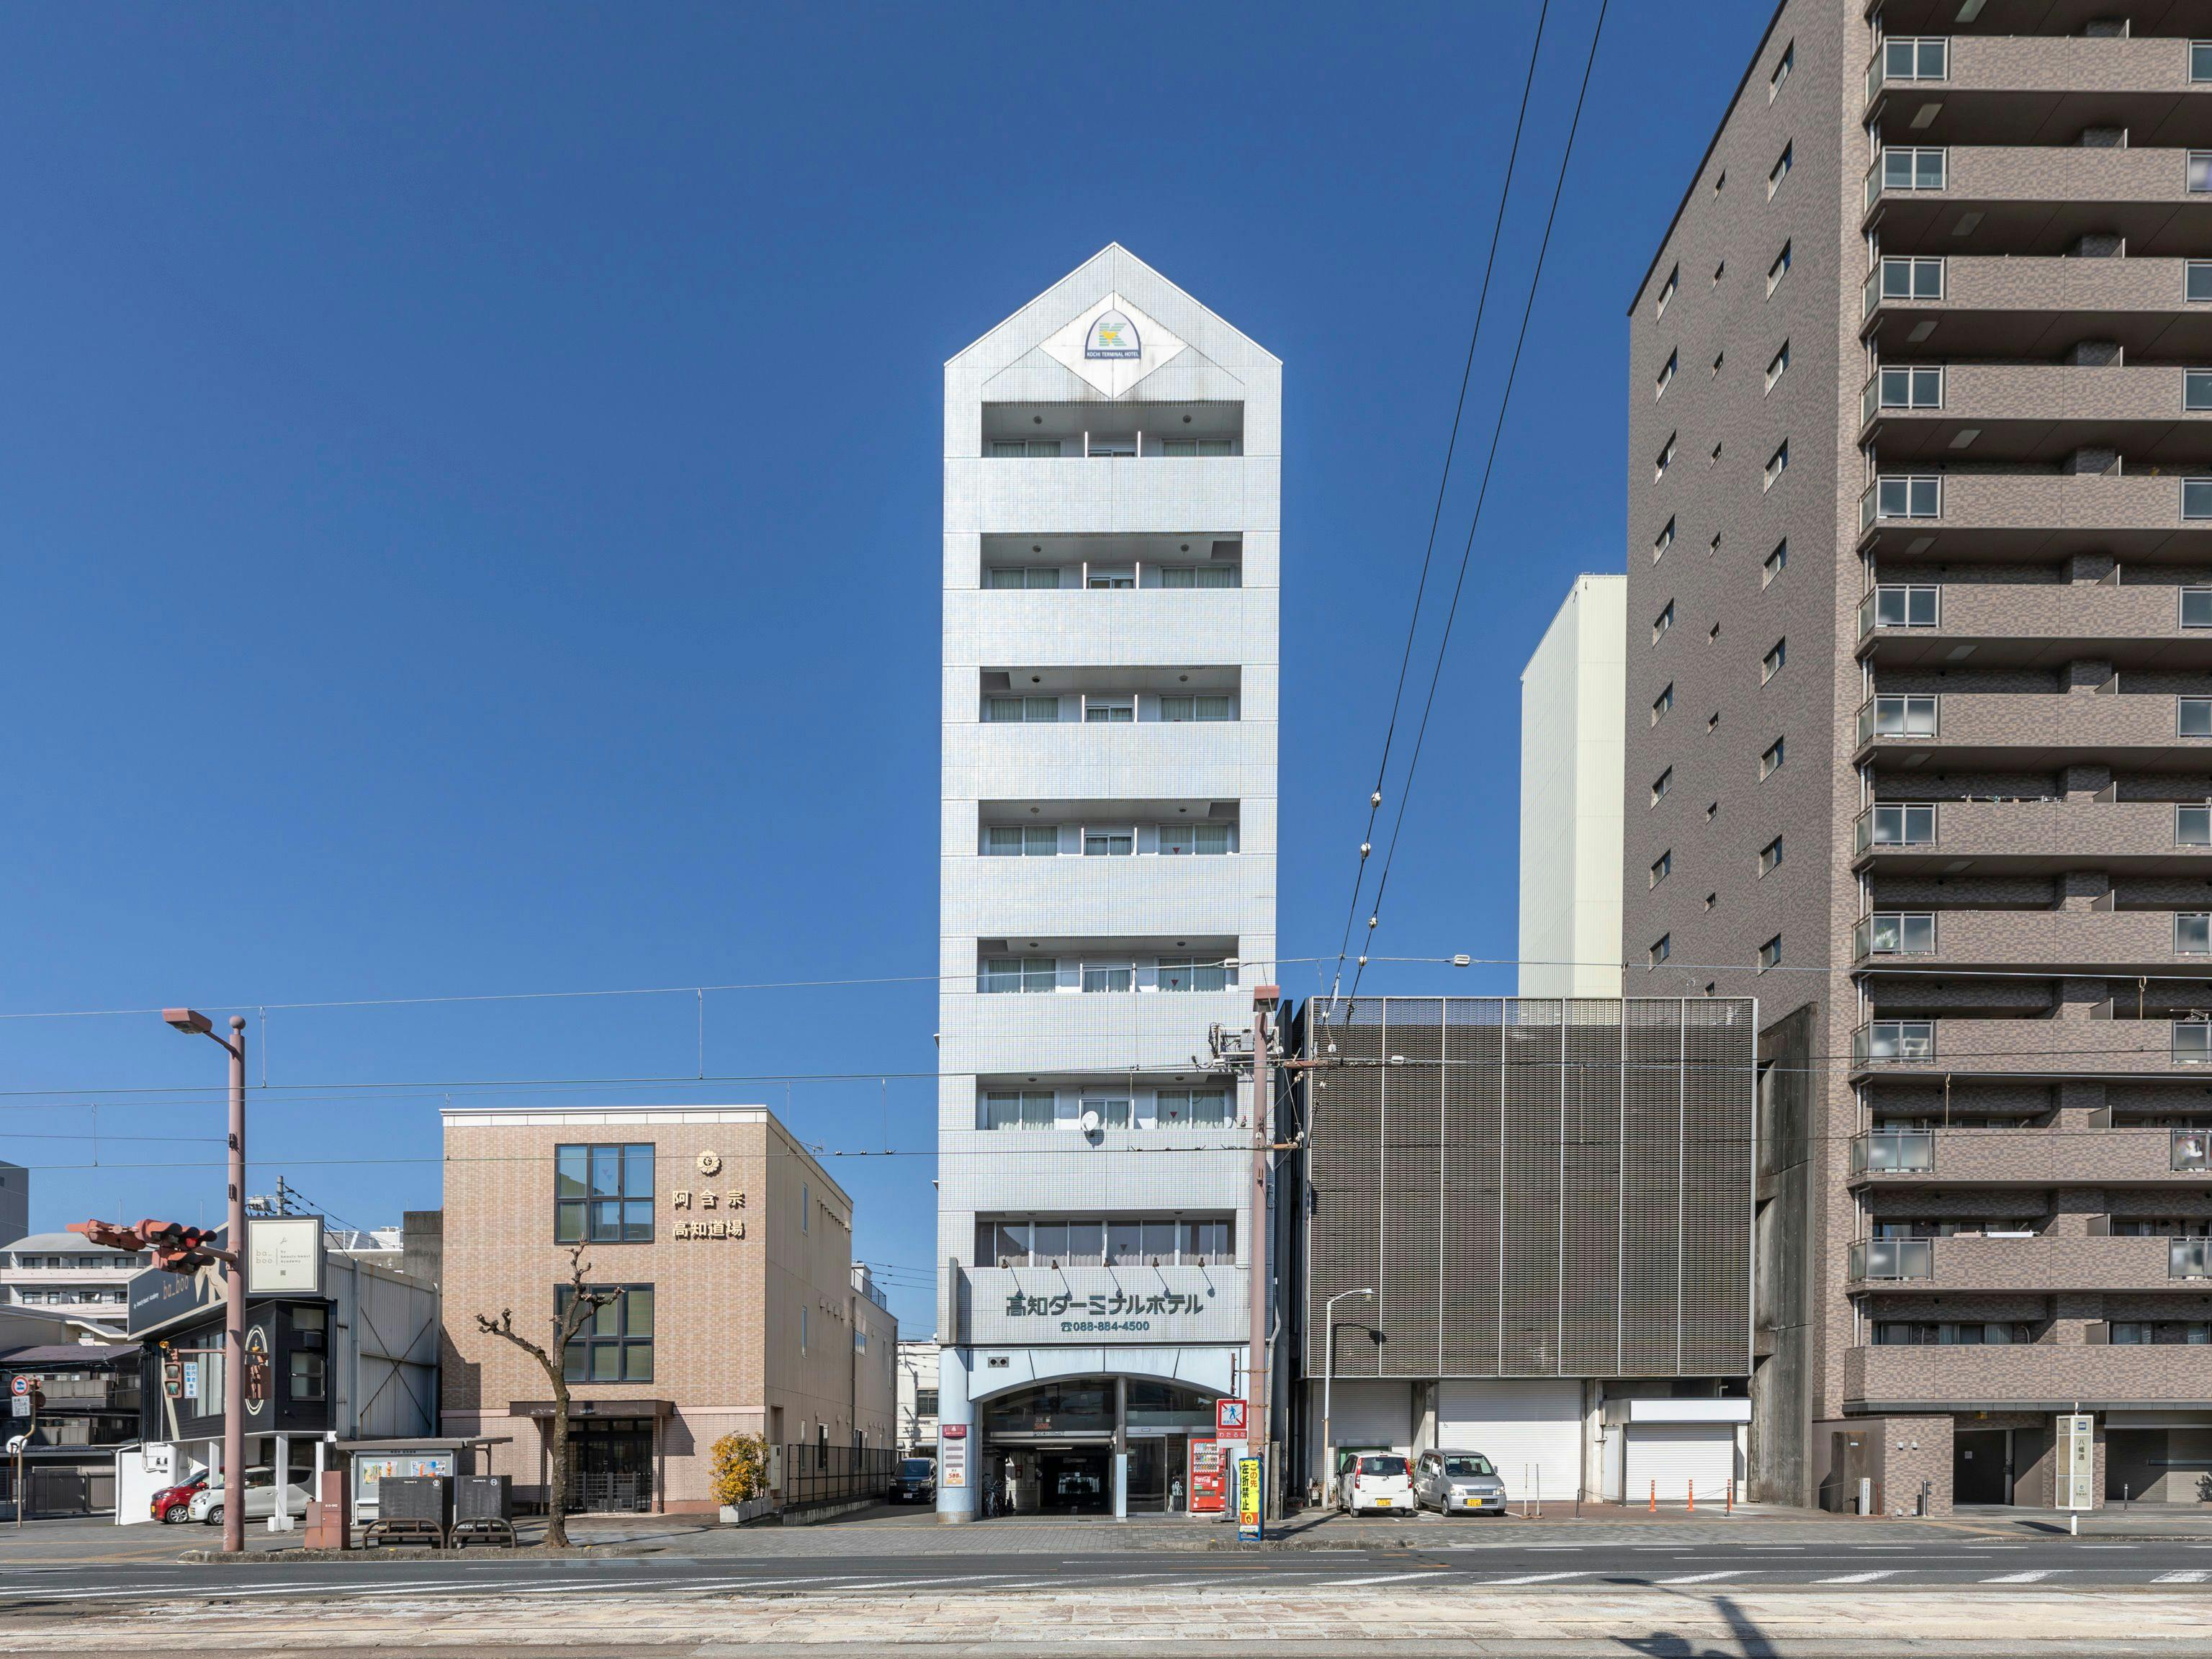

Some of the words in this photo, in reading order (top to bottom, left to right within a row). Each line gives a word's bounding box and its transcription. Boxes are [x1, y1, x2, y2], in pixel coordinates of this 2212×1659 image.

[673, 1189, 743, 1207] 阿含宗
[673, 1220, 743, 1238] 高知道場
[1006, 1295, 1204, 1316] 高知ターミナルホテル
[1073, 1321, 1150, 1331] 088-884-4500
